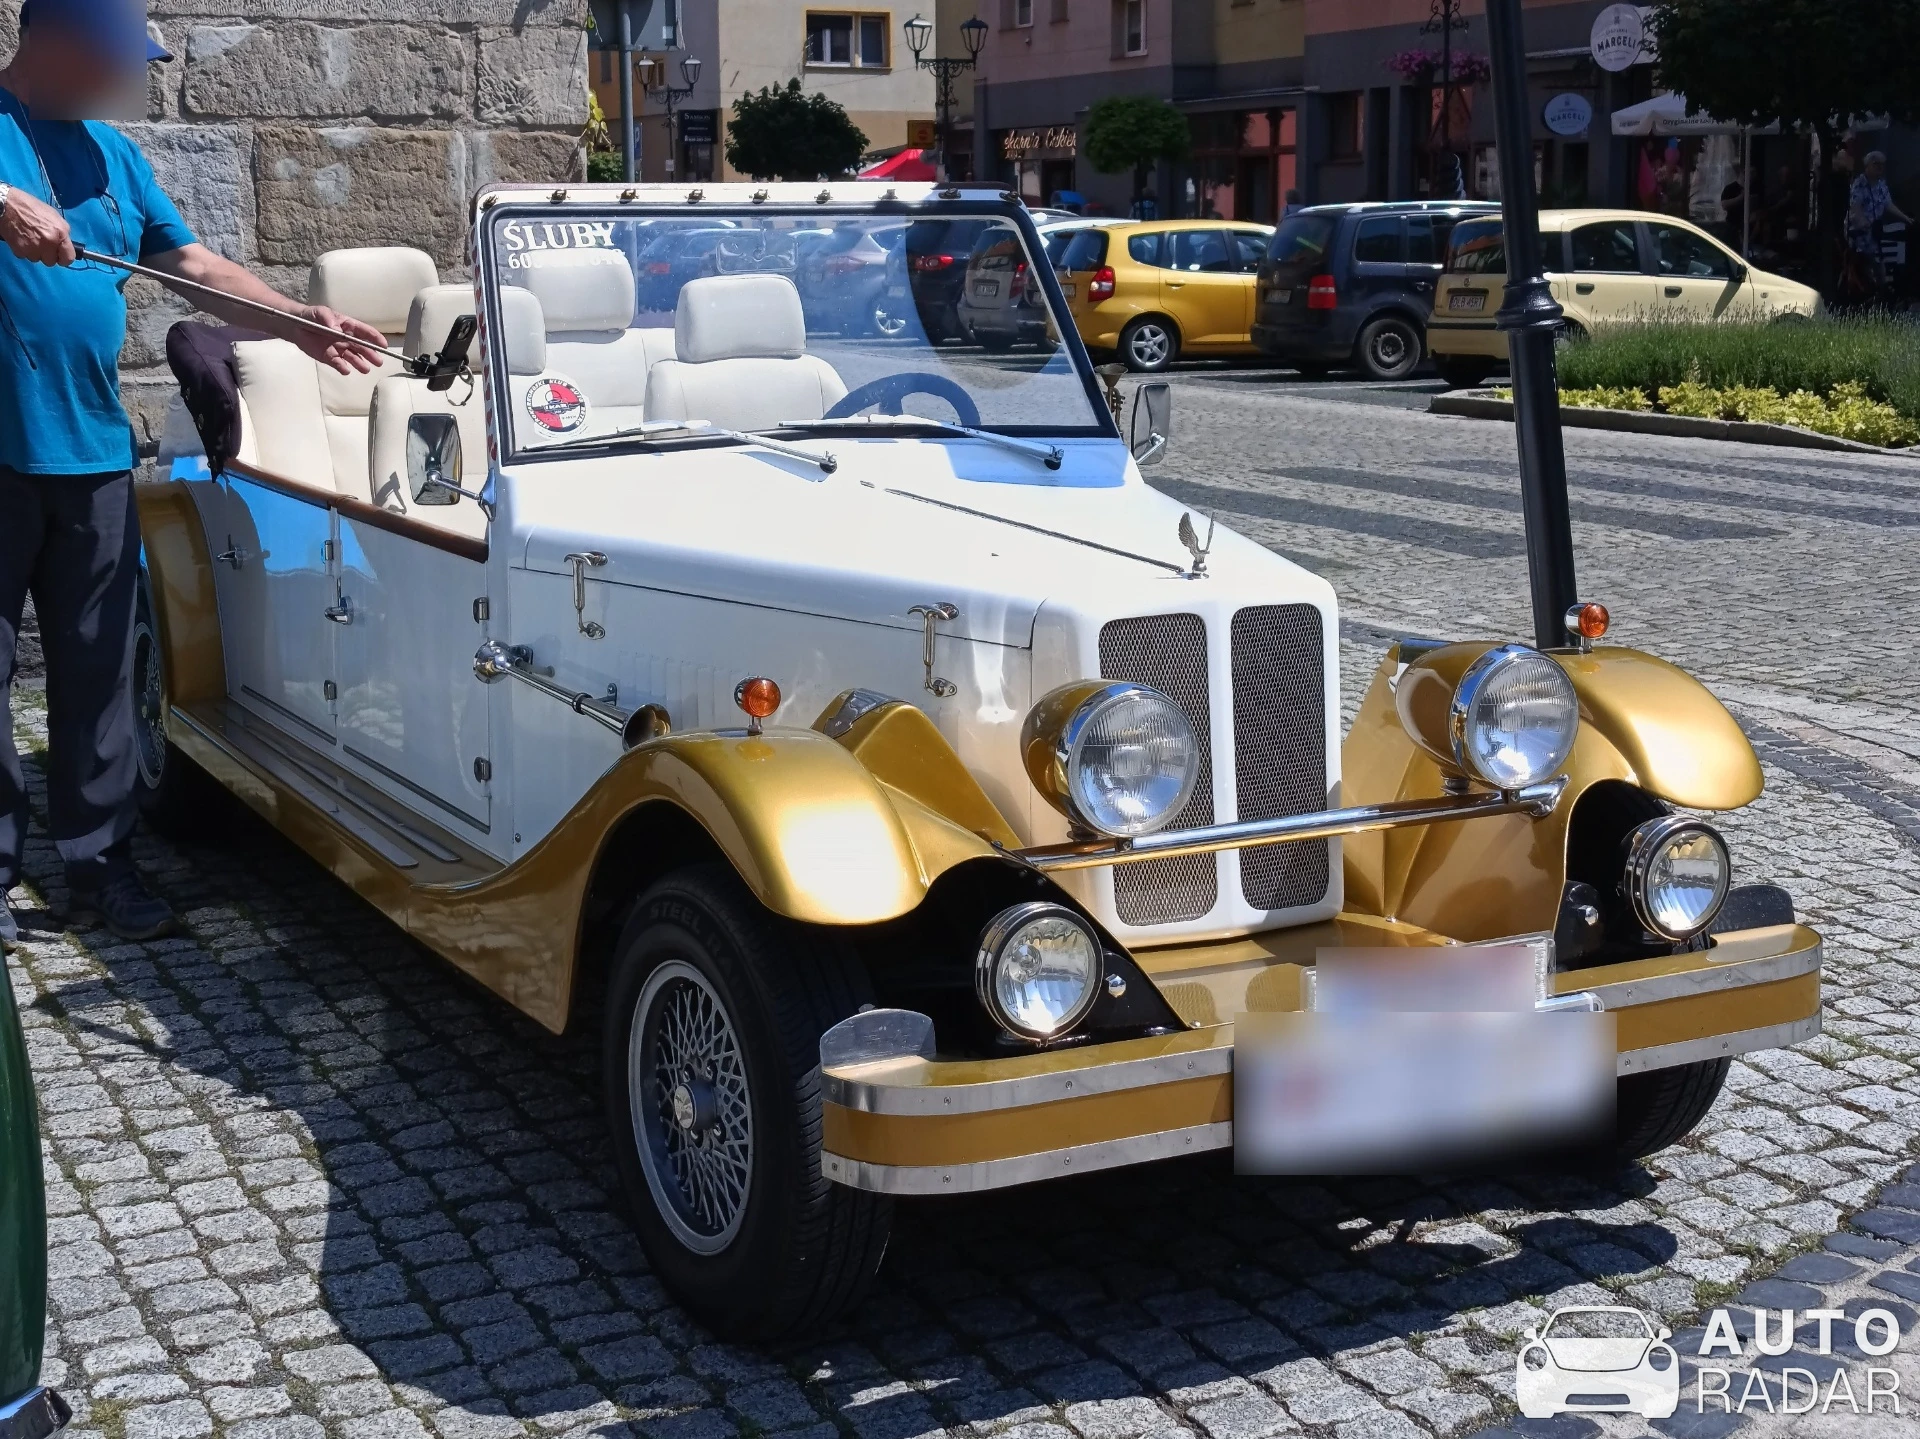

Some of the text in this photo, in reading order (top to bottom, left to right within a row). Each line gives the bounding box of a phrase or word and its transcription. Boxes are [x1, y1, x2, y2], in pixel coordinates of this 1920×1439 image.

[1597, 36, 1636, 53] MARCELI
[1550, 112, 1585, 123] MARCELI
[503, 219, 617, 251] ŚLUBY
[549, 379, 568, 387] KLUB
[570, 387, 584, 404] AUTO
[648, 900, 702, 935] STEEL
